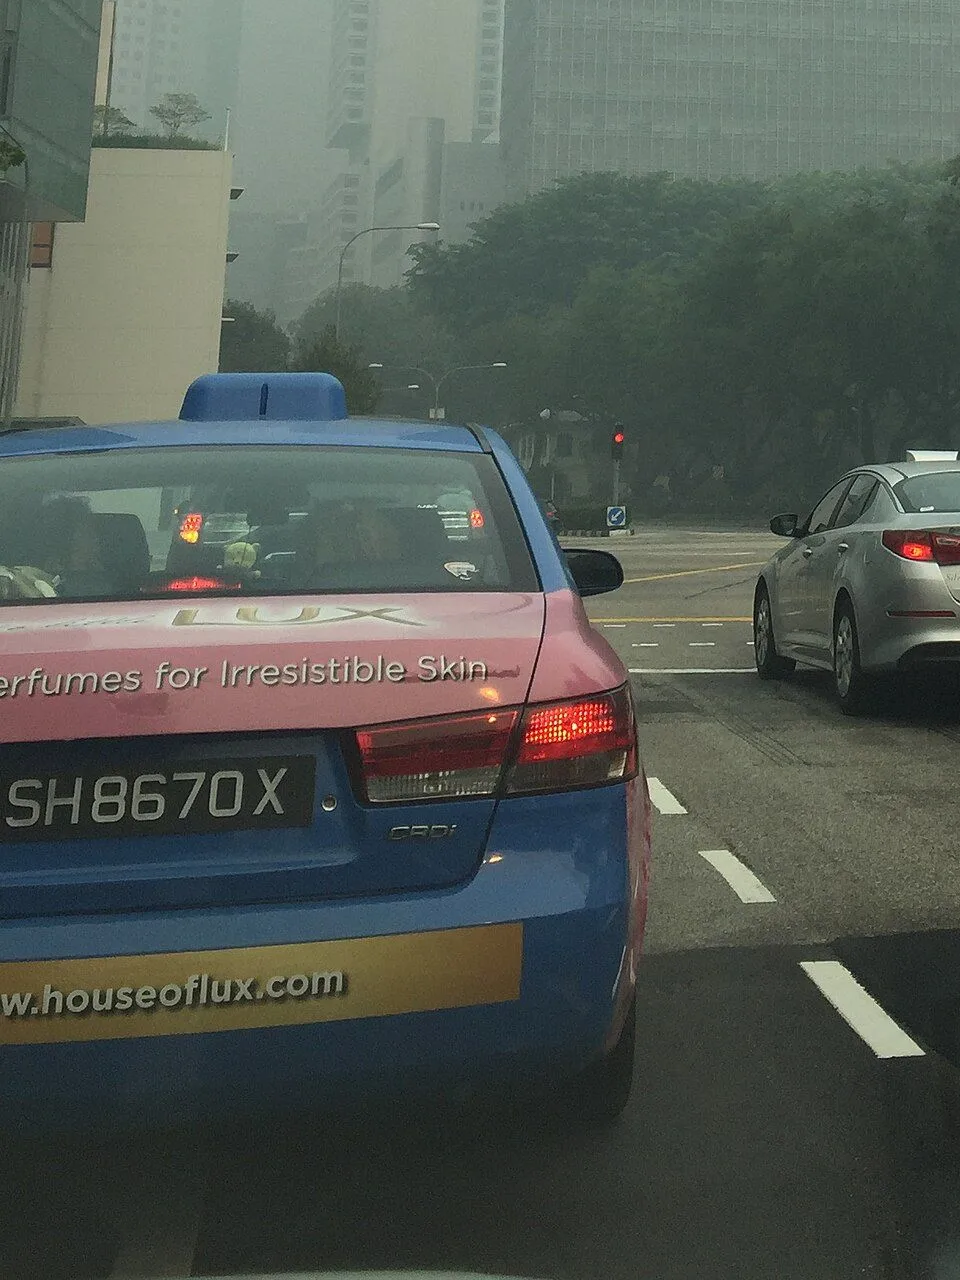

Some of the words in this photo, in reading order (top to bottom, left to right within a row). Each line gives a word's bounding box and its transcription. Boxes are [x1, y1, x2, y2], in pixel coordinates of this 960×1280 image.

[171, 607, 427, 628] LUX
[155, 661, 208, 690] for
[221, 655, 406, 687] Irresistible
[417, 655, 488, 682] Skin
[6, 767, 288, 828] SH8670X
[0, 970, 345, 1017] w.houseoflux.com
